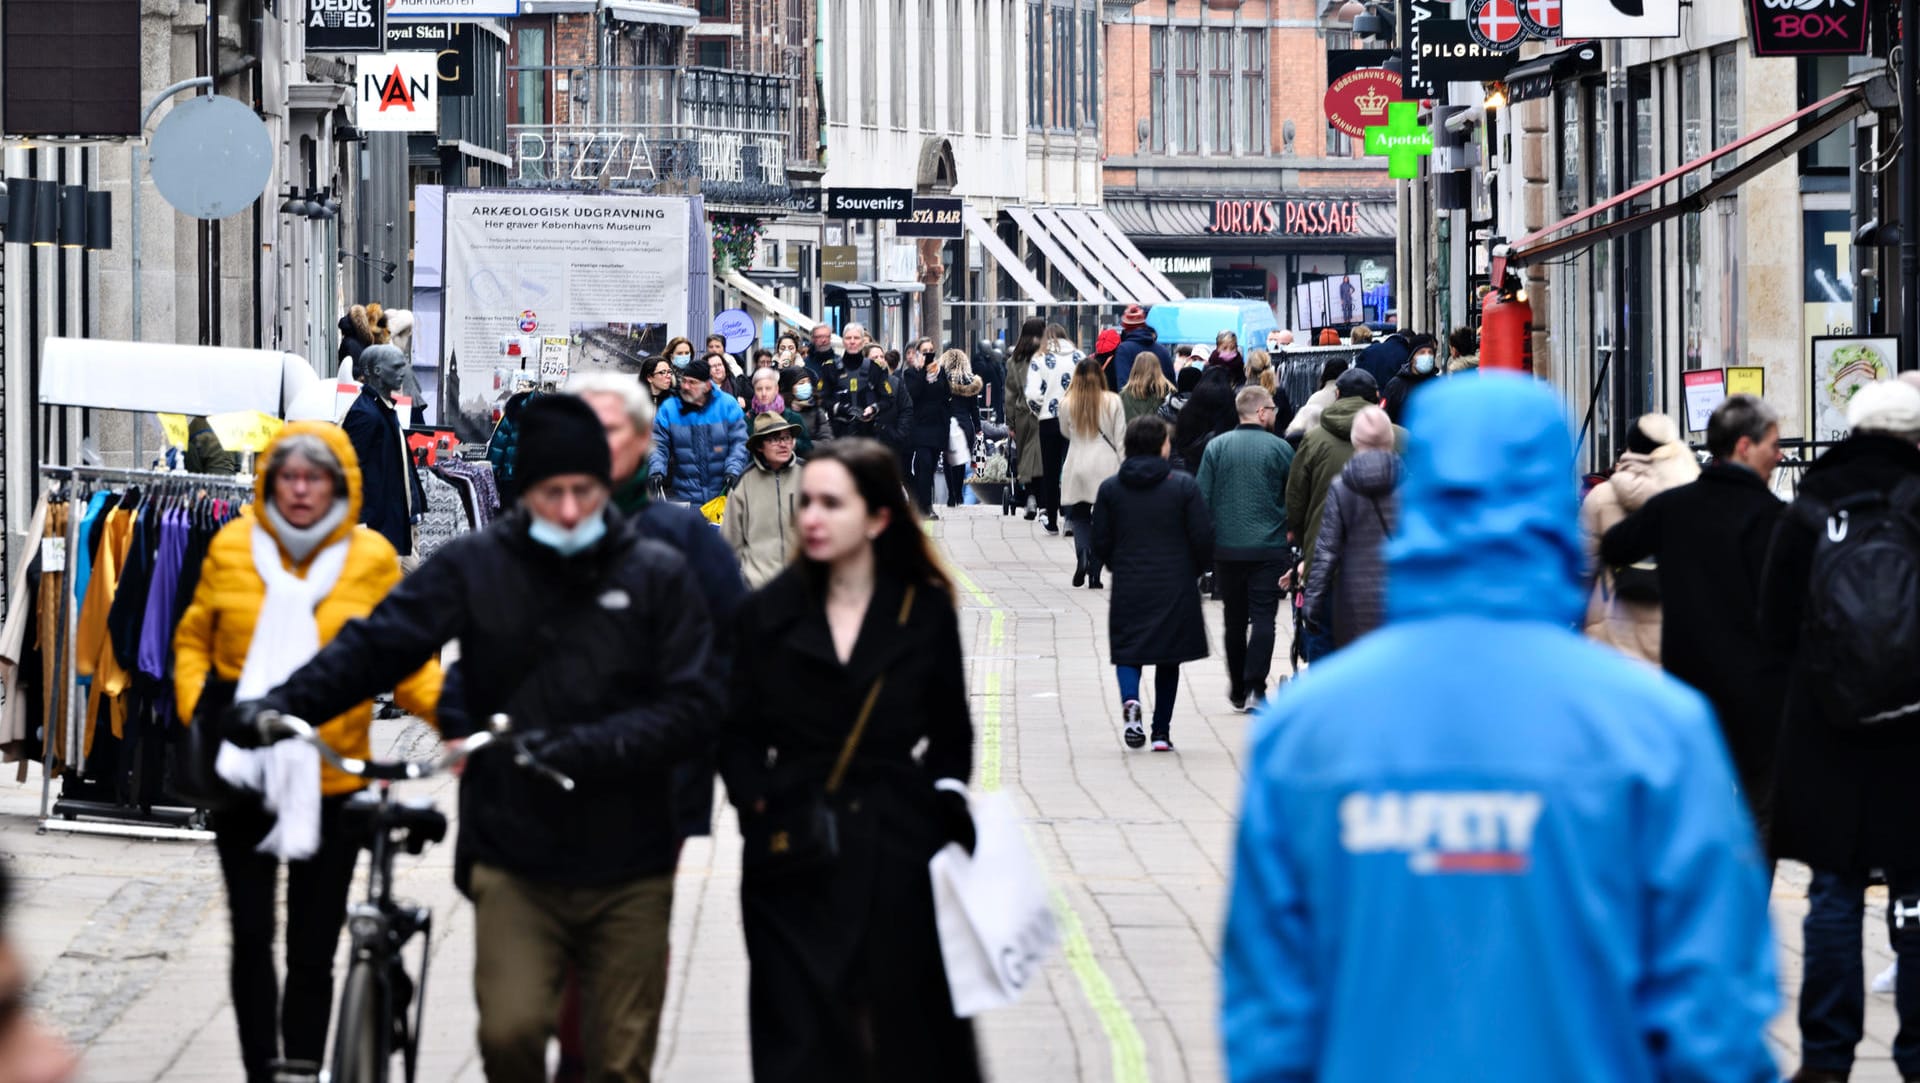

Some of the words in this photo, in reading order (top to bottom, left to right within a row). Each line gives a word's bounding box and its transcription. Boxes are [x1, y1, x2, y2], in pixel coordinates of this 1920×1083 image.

[387, 26, 412, 40] oyal
[416, 25, 445, 39] Skin
[1772, 13, 1849, 39] BOX
[365, 64, 429, 112] IVAN
[1376, 133, 1431, 149] Apotek
[518, 132, 656, 180] PIZZA
[836, 195, 904, 210] Souvenirs
[472, 206, 570, 218] ARKÆOLOGISK
[574, 207, 665, 219] UDGRAVNING
[936, 209, 961, 223] BAR
[1210, 200, 1275, 234] JORCKS
[1284, 201, 1361, 234] PASSAGE
[484, 219, 504, 229] Her
[506, 221, 539, 231] graver
[541, 219, 604, 231] Københavns
[606, 221, 651, 231] Museum
[1339, 790, 1542, 852] SAFETY
